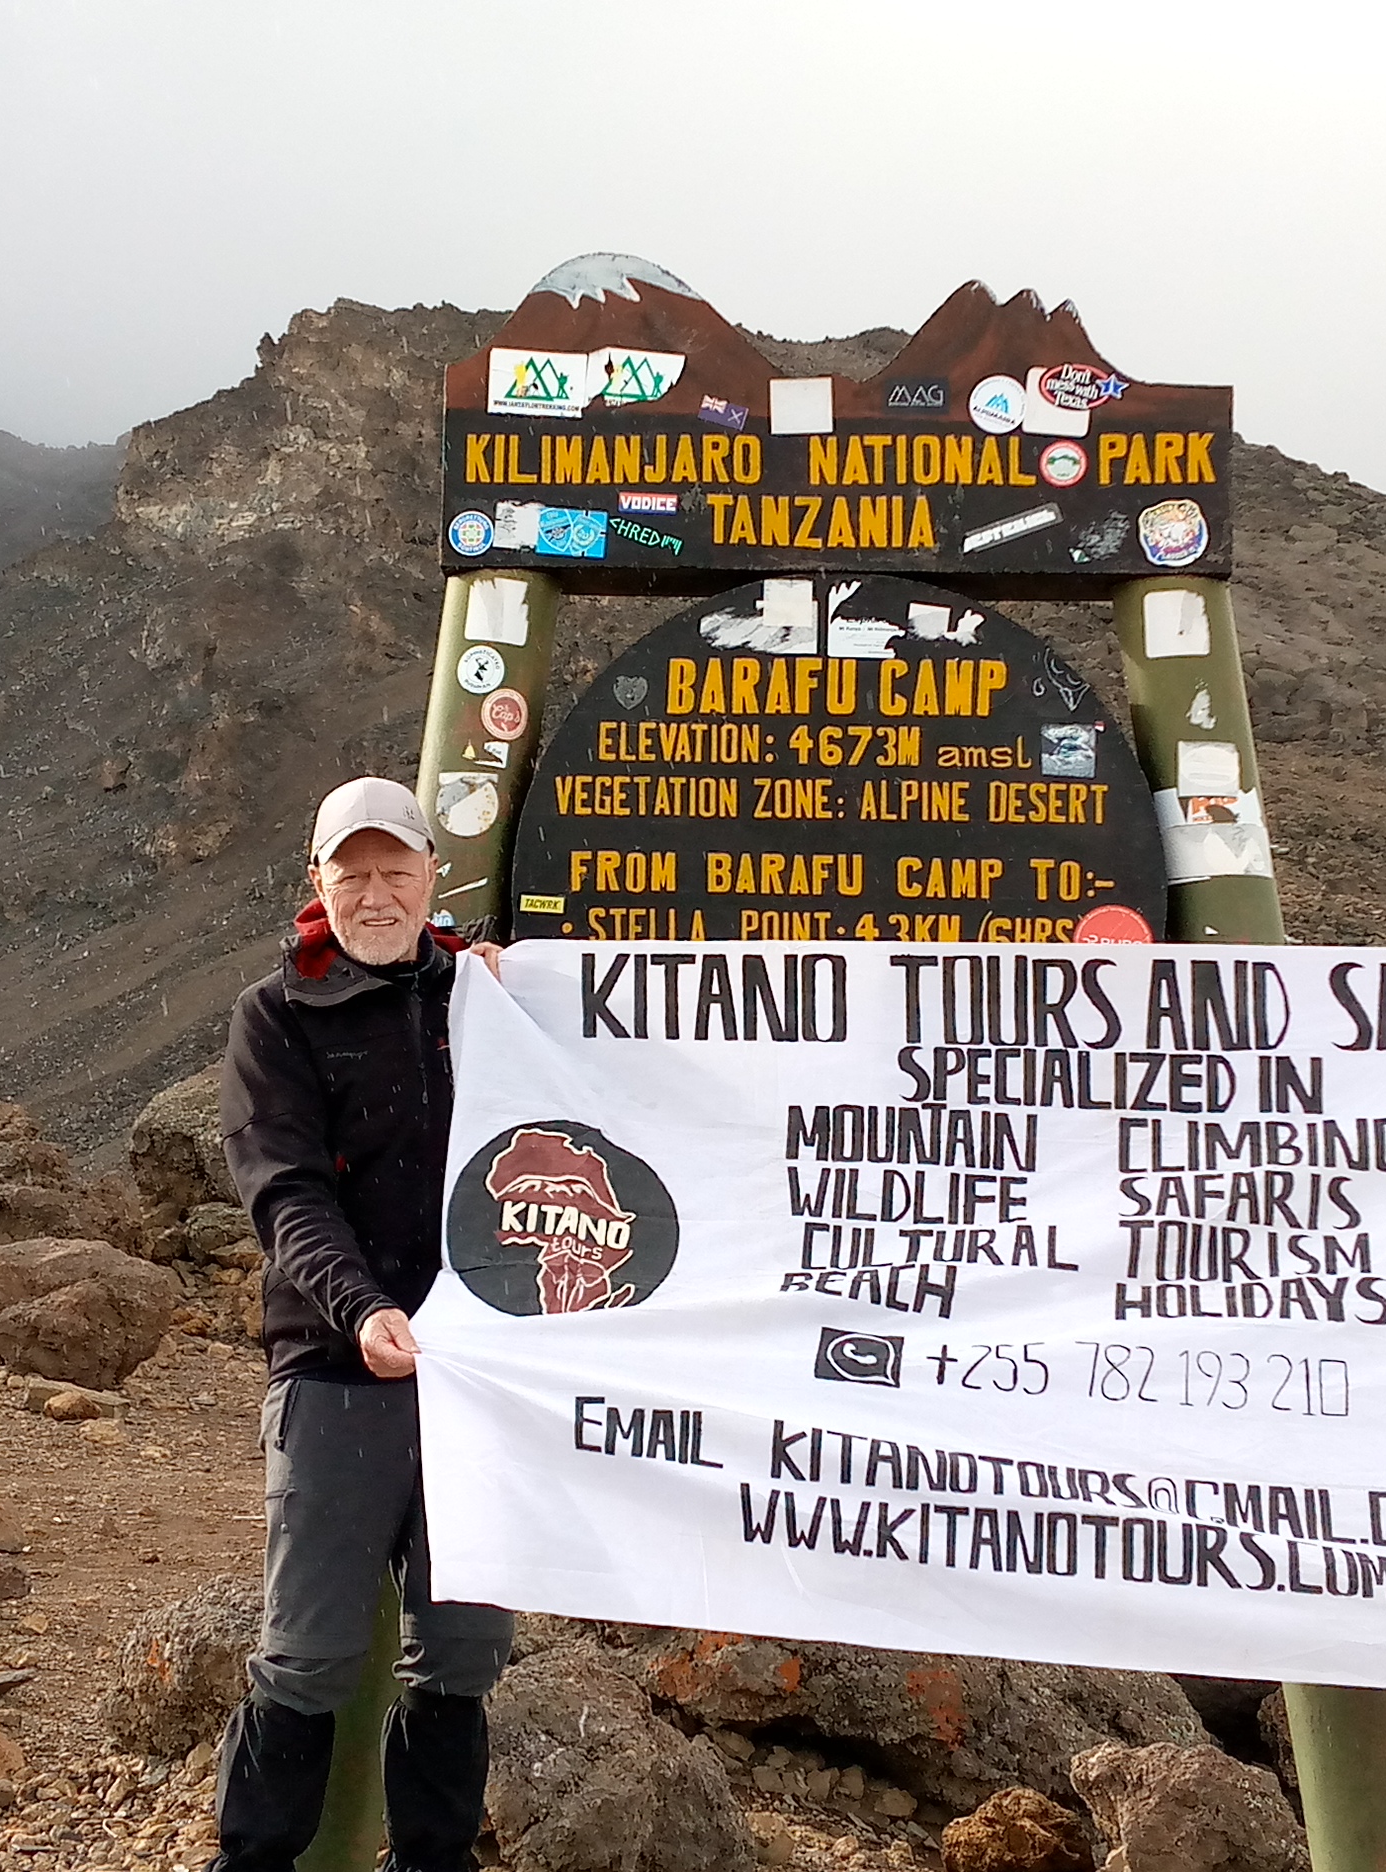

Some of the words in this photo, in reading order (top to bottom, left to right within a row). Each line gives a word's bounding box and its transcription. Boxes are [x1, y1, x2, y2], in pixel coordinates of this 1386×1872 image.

[888, 384, 944, 405] MAG
[1046, 378, 1075, 393] mess
[1075, 384, 1099, 400] with
[465, 432, 763, 486] KILIMANJARO
[808, 433, 1038, 487] NATIONAL
[1097, 430, 1218, 486] PARK
[619, 494, 679, 512] VODICE
[705, 492, 936, 550] TANZANIA
[665, 656, 859, 717] BARAFU
[878, 657, 1009, 718] CAMP
[597, 720, 776, 765] ELEVATION:
[788, 725, 922, 769] 4673M
[936, 738, 1032, 770] amsl
[554, 774, 739, 820] VEGETATION
[752, 776, 846, 821] ZONE:
[859, 779, 971, 824] ALPINE
[987, 779, 1110, 826] DESERT
[569, 850, 677, 896] FROM
[706, 851, 864, 898] BARAFU
[896, 855, 1004, 902] CAMP
[1028, 857, 1116, 903] TO:-
[587, 906, 707, 942] STELLA
[853, 912, 962, 943] 43KM
[580, 951, 848, 1044] KITANO
[888, 954, 1123, 1051] TOURS
[1145, 957, 1291, 1053] AND
[897, 1045, 1237, 1114] SPECIALIZED
[1257, 1054, 1324, 1115] IN
[785, 1103, 1039, 1173] MOUNTAIN
[500, 1199, 633, 1252] KITANO
[785, 1166, 1029, 1225] WILDLIFE
[1117, 1170, 1362, 1231] SAFARIS
[549, 1237, 603, 1261] tours
[800, 1221, 1080, 1272] CULTURAL
[1117, 1219, 1373, 1284] TOURISM
[778, 1262, 958, 1320] BEACH
[925, 1342, 1050, 1395] +255
[1074, 1340, 1160, 1402] 782
[1178, 1349, 1251, 1410] 193
[1266, 1353, 1350, 1417] 210
[573, 1396, 724, 1469] EMAIL
